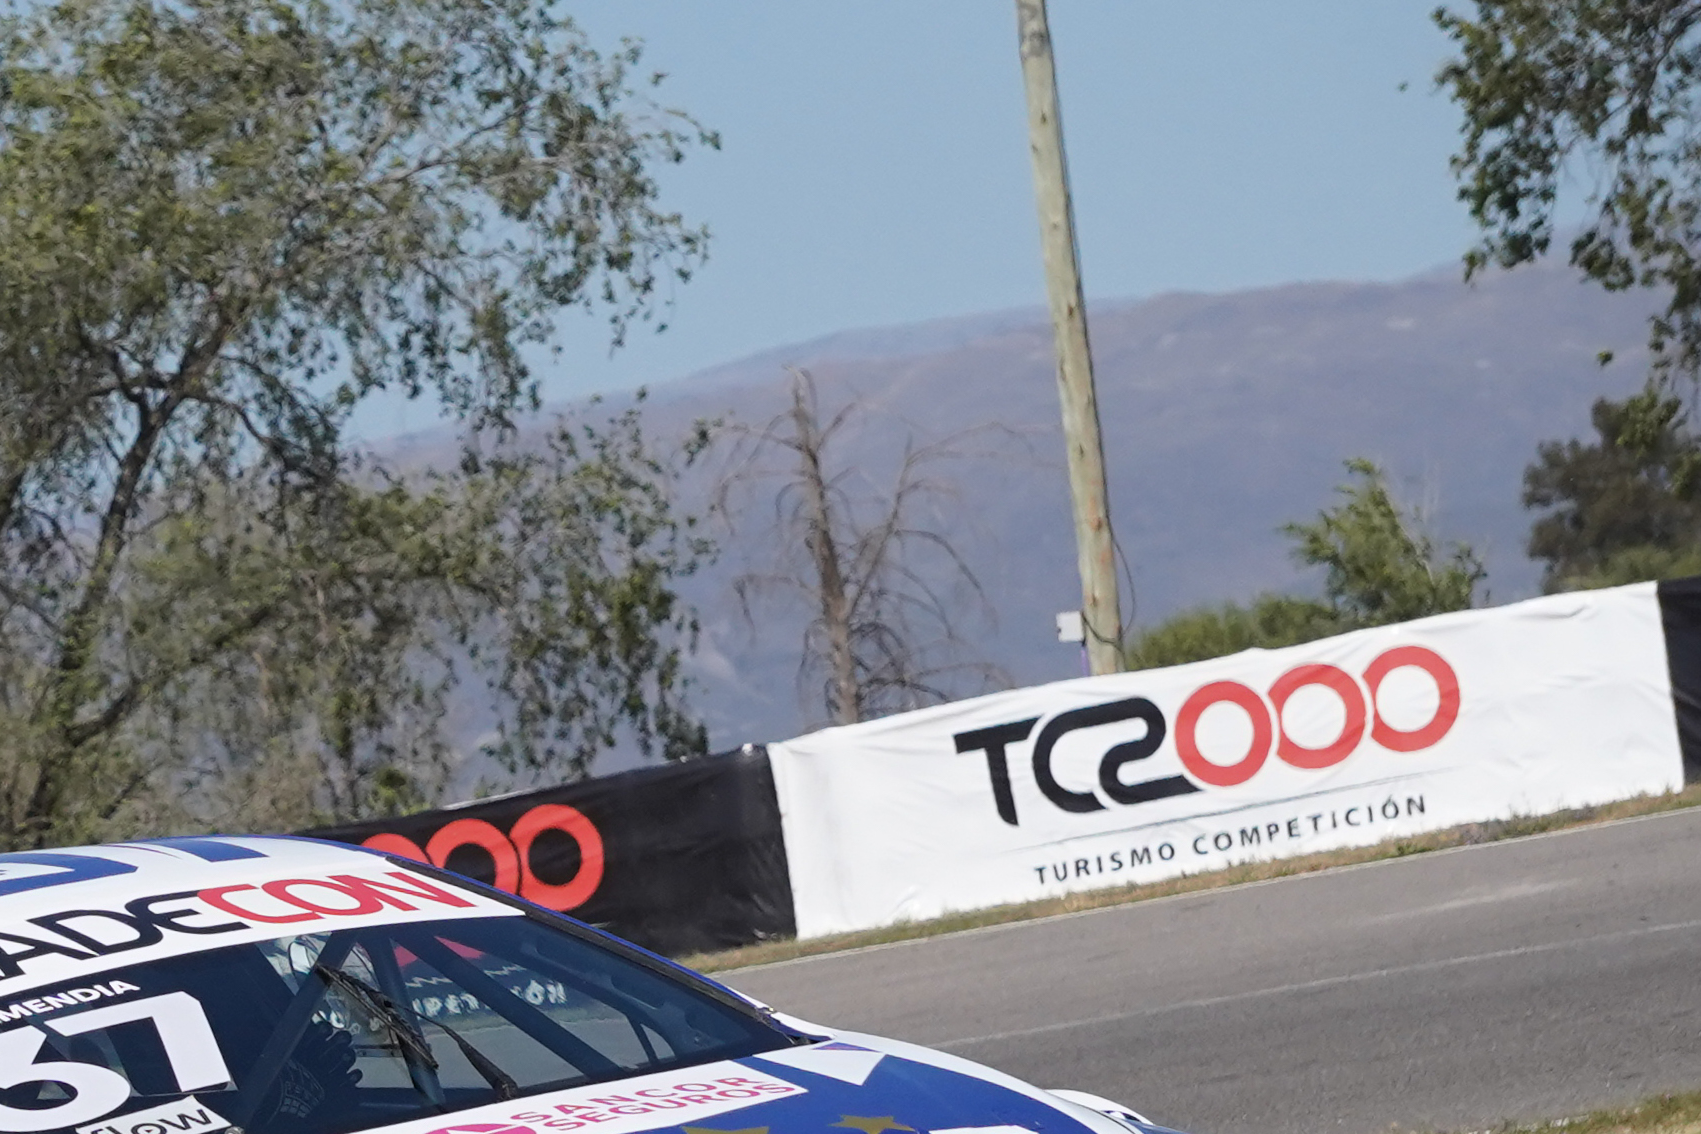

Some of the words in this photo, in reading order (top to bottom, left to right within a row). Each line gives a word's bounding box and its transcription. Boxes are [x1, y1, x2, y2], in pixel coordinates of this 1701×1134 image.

[953, 645, 1460, 827] TC2000
[1034, 843, 1175, 885] TURISMO
[1193, 794, 1426, 856] COMPETICIÓN
[510, 1077, 762, 1124] SANCOR
[543, 1084, 796, 1132] SEGUROS
